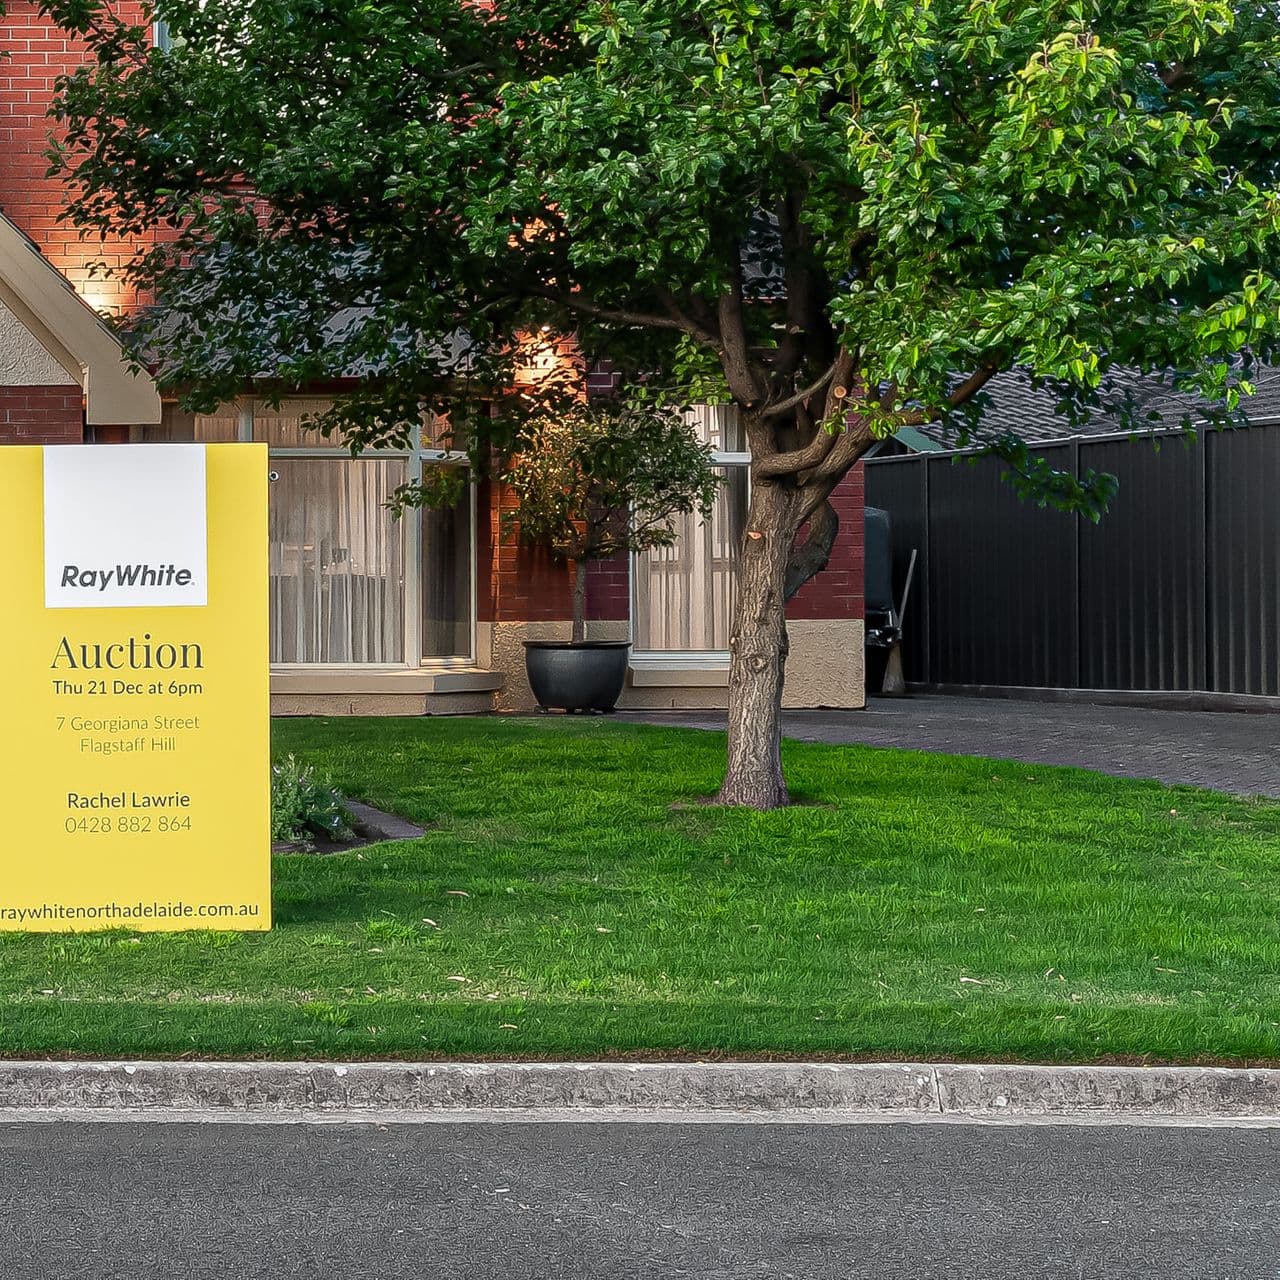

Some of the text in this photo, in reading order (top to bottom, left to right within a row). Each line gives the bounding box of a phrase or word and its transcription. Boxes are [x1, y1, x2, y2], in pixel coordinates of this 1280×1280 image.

[50, 633, 204, 670] Auction
[52, 680, 203, 697] Thu 21 Dec at 6pm
[56, 715, 200, 733] 7 Georgiana Street
[80, 737, 176, 756] Flagstaff Hill
[67, 791, 191, 809] Rachel Lawrie
[65, 815, 192, 834] 0428 882 864
[0, 903, 260, 922] raywhitenorthadelaide.com.au
